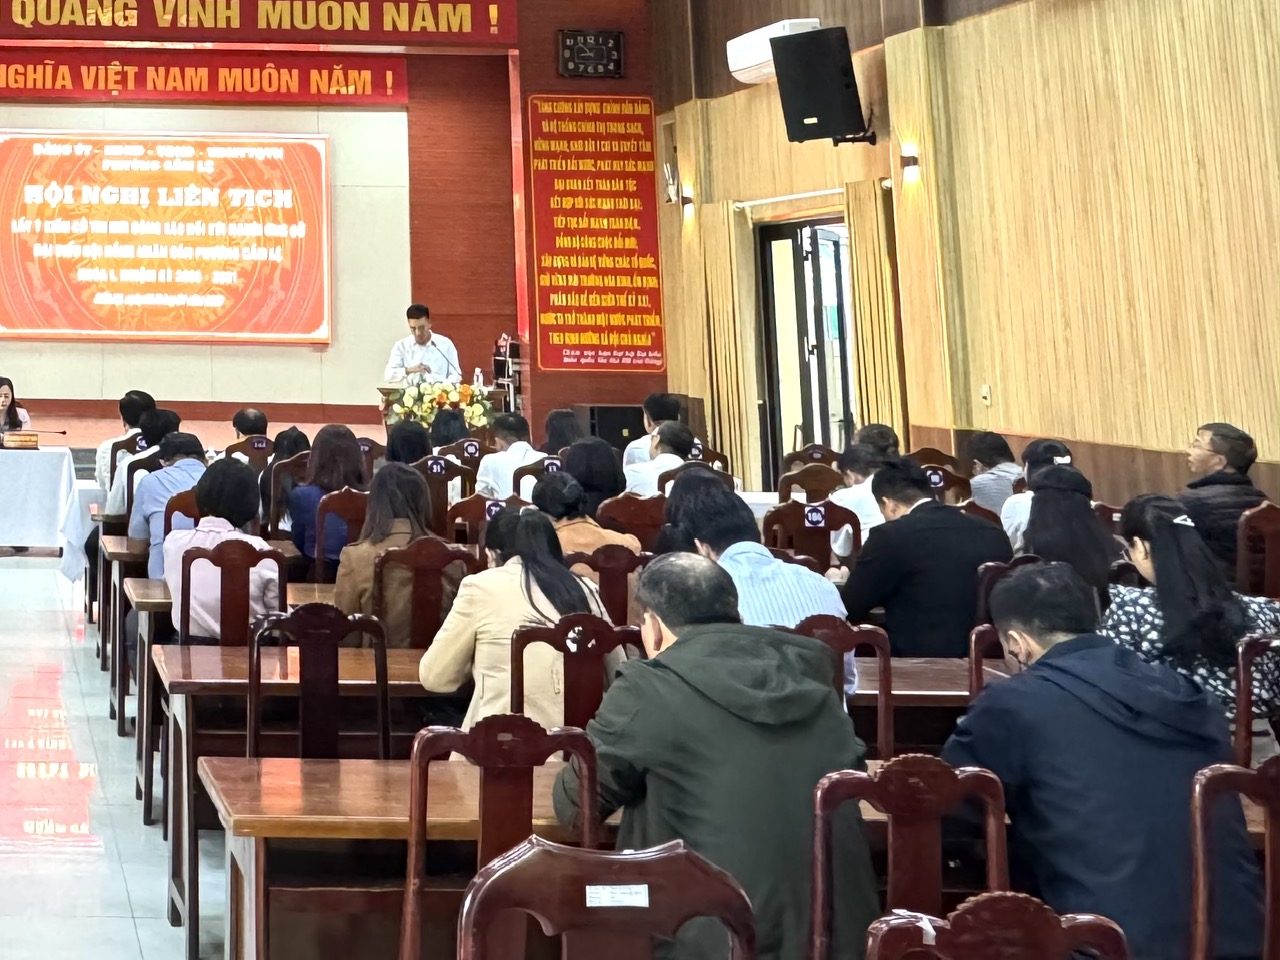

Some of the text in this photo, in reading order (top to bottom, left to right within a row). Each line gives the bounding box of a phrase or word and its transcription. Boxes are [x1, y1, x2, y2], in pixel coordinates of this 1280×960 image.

[80, 60, 138, 96] VIỆT
[146, 66, 208, 93] NAM
[218, 63, 299, 93] MUÔN
[310, 64, 372, 95] NĂM
[24, 180, 293, 211] HỘI NGHỊ LIÊN TỊCH
